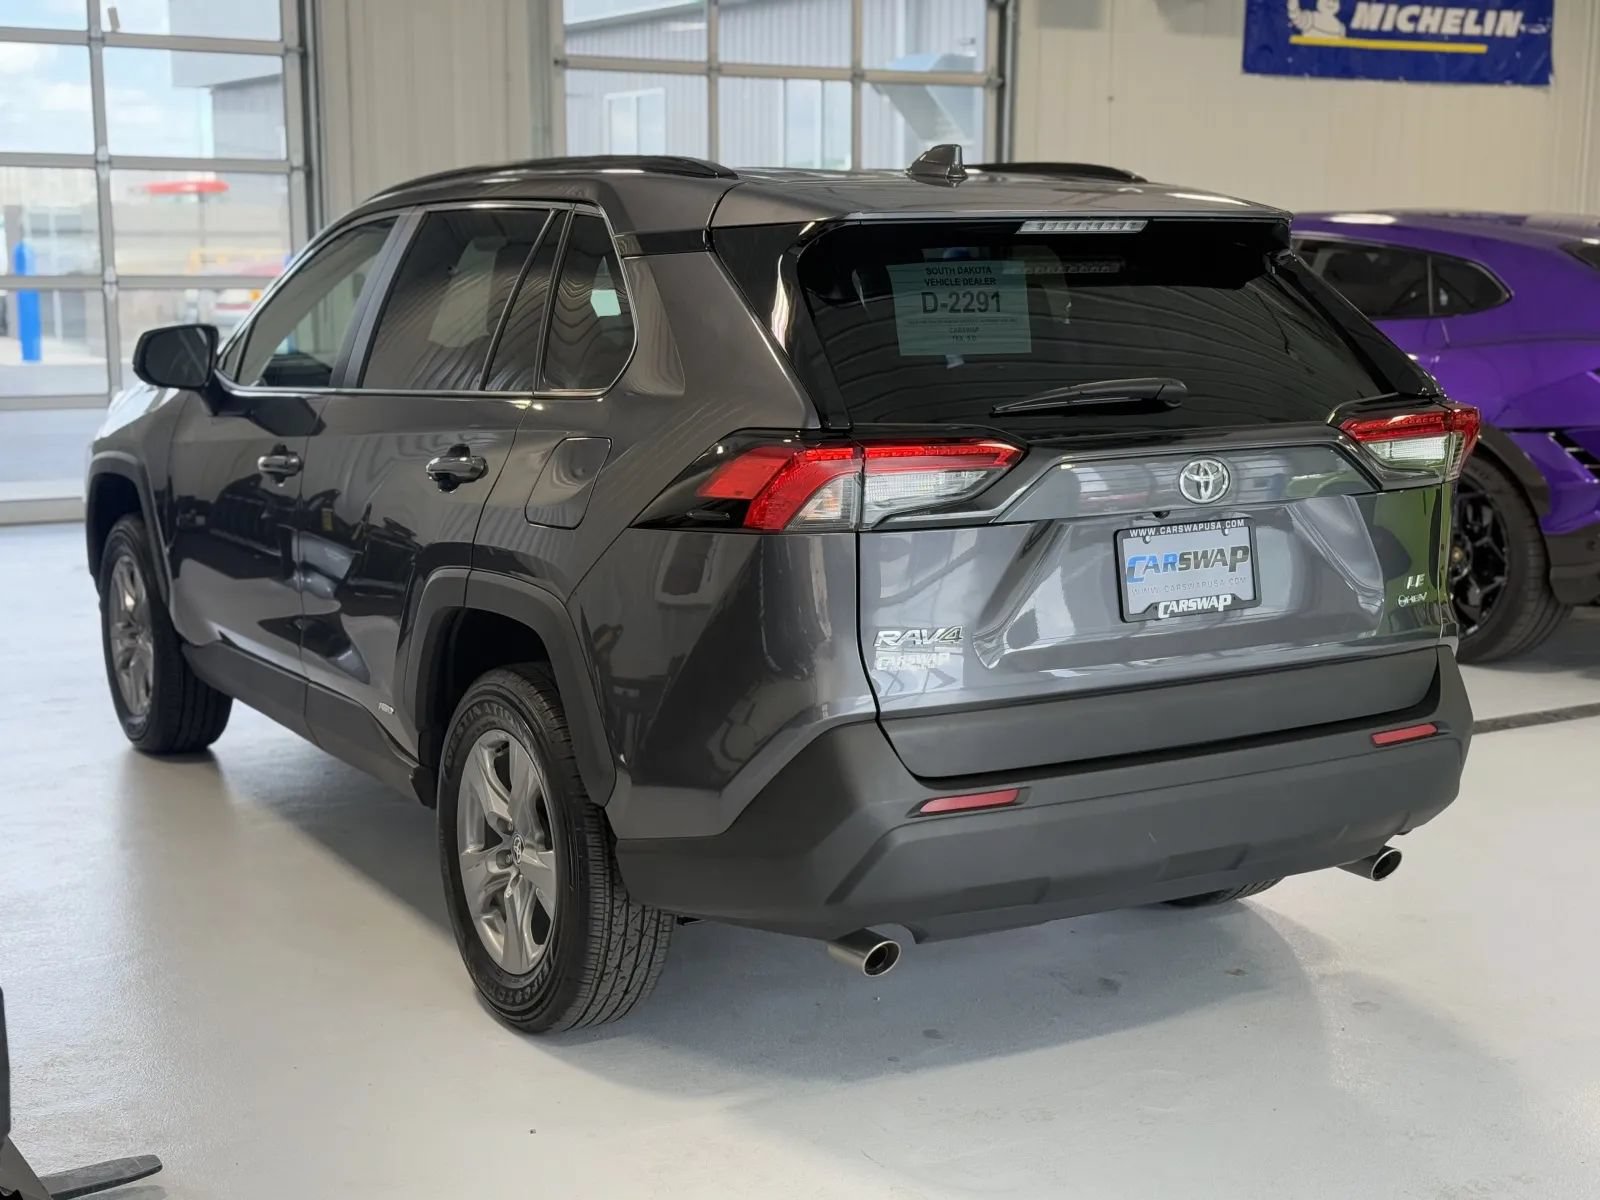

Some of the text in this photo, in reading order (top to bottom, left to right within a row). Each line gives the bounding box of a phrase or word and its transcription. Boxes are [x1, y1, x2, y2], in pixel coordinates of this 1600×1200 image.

[1350, 2, 1523, 37] MICHELIN
[926, 265, 992, 275] SOUTH DAKOTA
[925, 276, 997, 286] VEHICLE DEALER
[921, 290, 1001, 313] D-2291
[1129, 519, 1245, 537] WWW.CARSWAPUSA.COM
[1126, 545, 1250, 583] CARSWAP
[1407, 573, 1425, 589] LE
[1158, 594, 1232, 619] CARSWAP
[873, 626, 963, 647] RAV4
